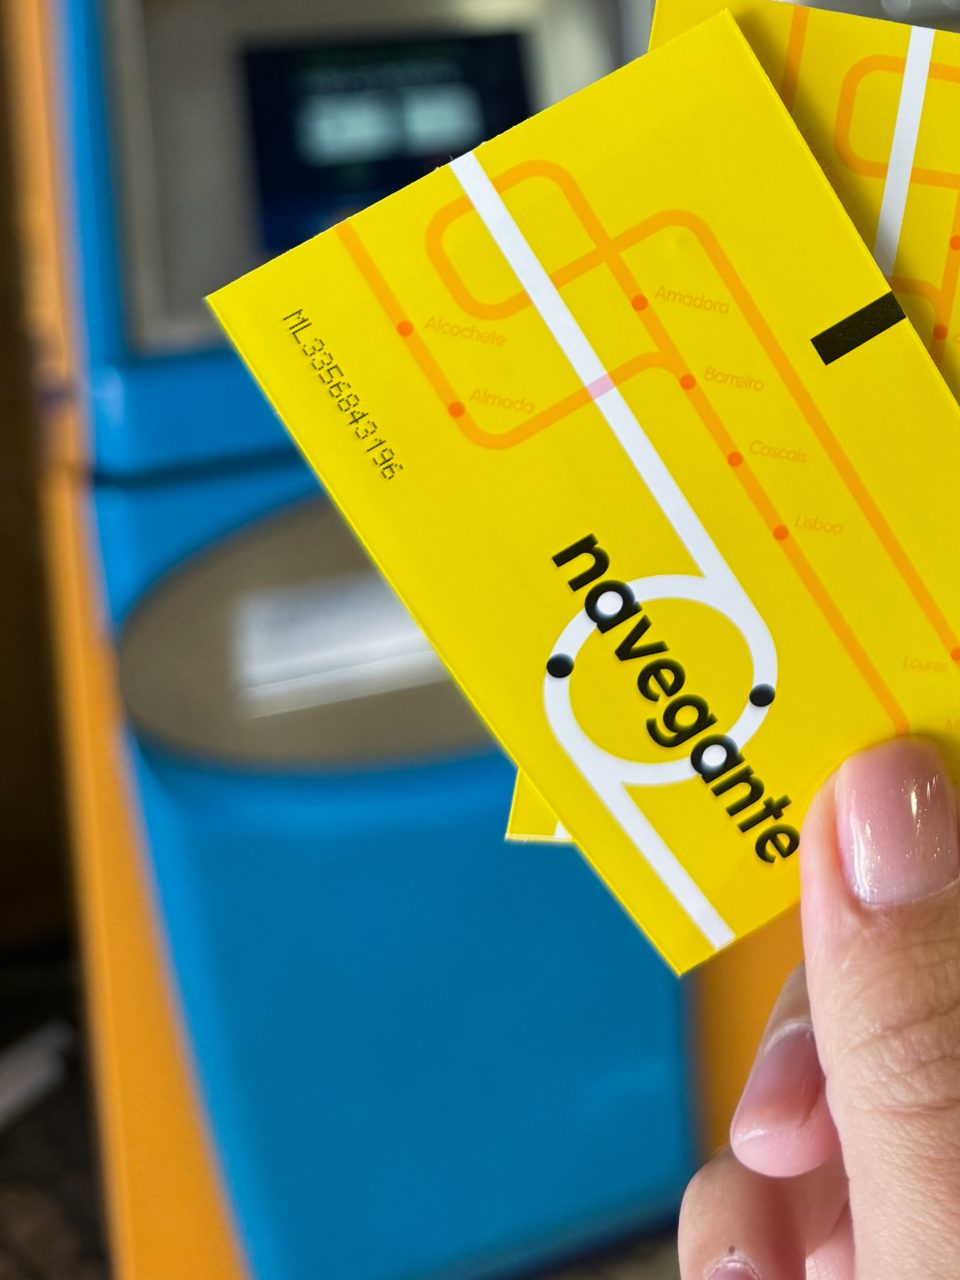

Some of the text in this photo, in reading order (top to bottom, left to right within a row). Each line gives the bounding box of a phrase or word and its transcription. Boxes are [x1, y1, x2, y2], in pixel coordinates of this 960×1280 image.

[653, 285, 731, 315] Amadora
[423, 315, 508, 347] Alcochete
[703, 366, 765, 393] Barreiro
[282, 308, 404, 481] ML3356843196
[468, 387, 536, 414] Almada
[748, 439, 809, 465] Cascais
[793, 512, 845, 536] Lisboa
[551, 533, 801, 865] navegante
